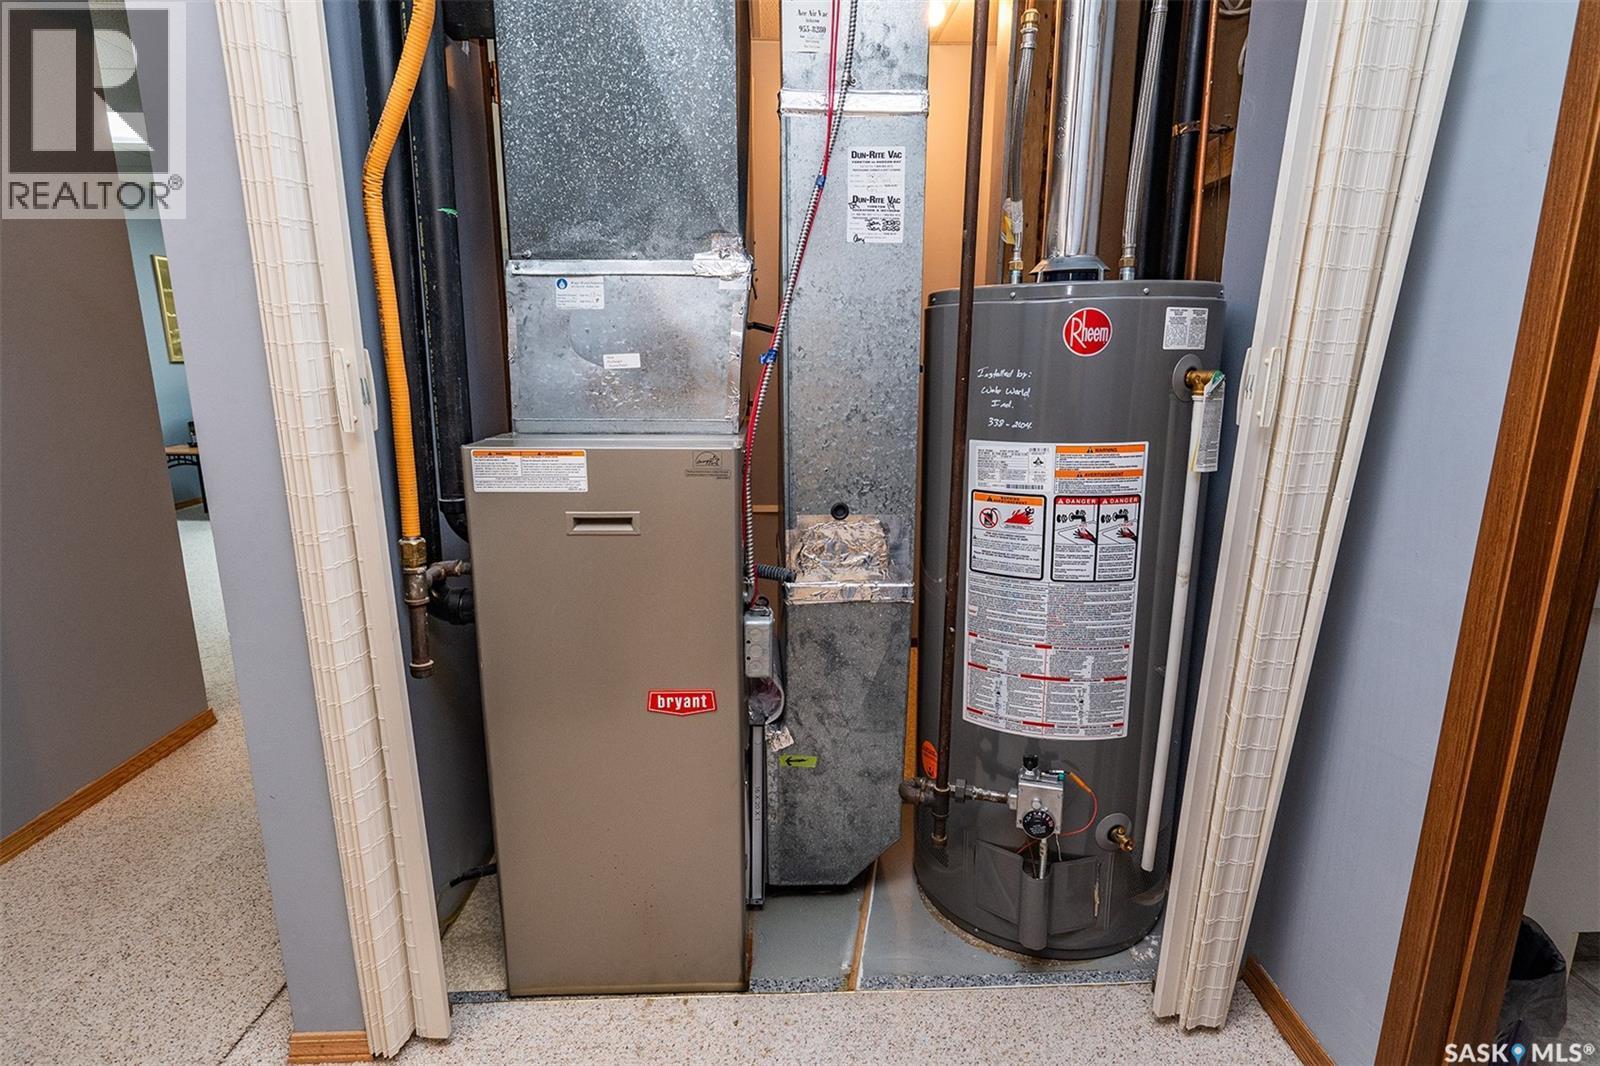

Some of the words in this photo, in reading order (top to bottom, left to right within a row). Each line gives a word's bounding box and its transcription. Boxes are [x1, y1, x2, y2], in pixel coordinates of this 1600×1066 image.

[887, 150, 903, 159] VAC
[887, 195, 902, 204] VAC
[1069, 310, 1109, 349] Rheem
[977, 366, 1014, 379] Installed
[657, 694, 707, 710] bryant
